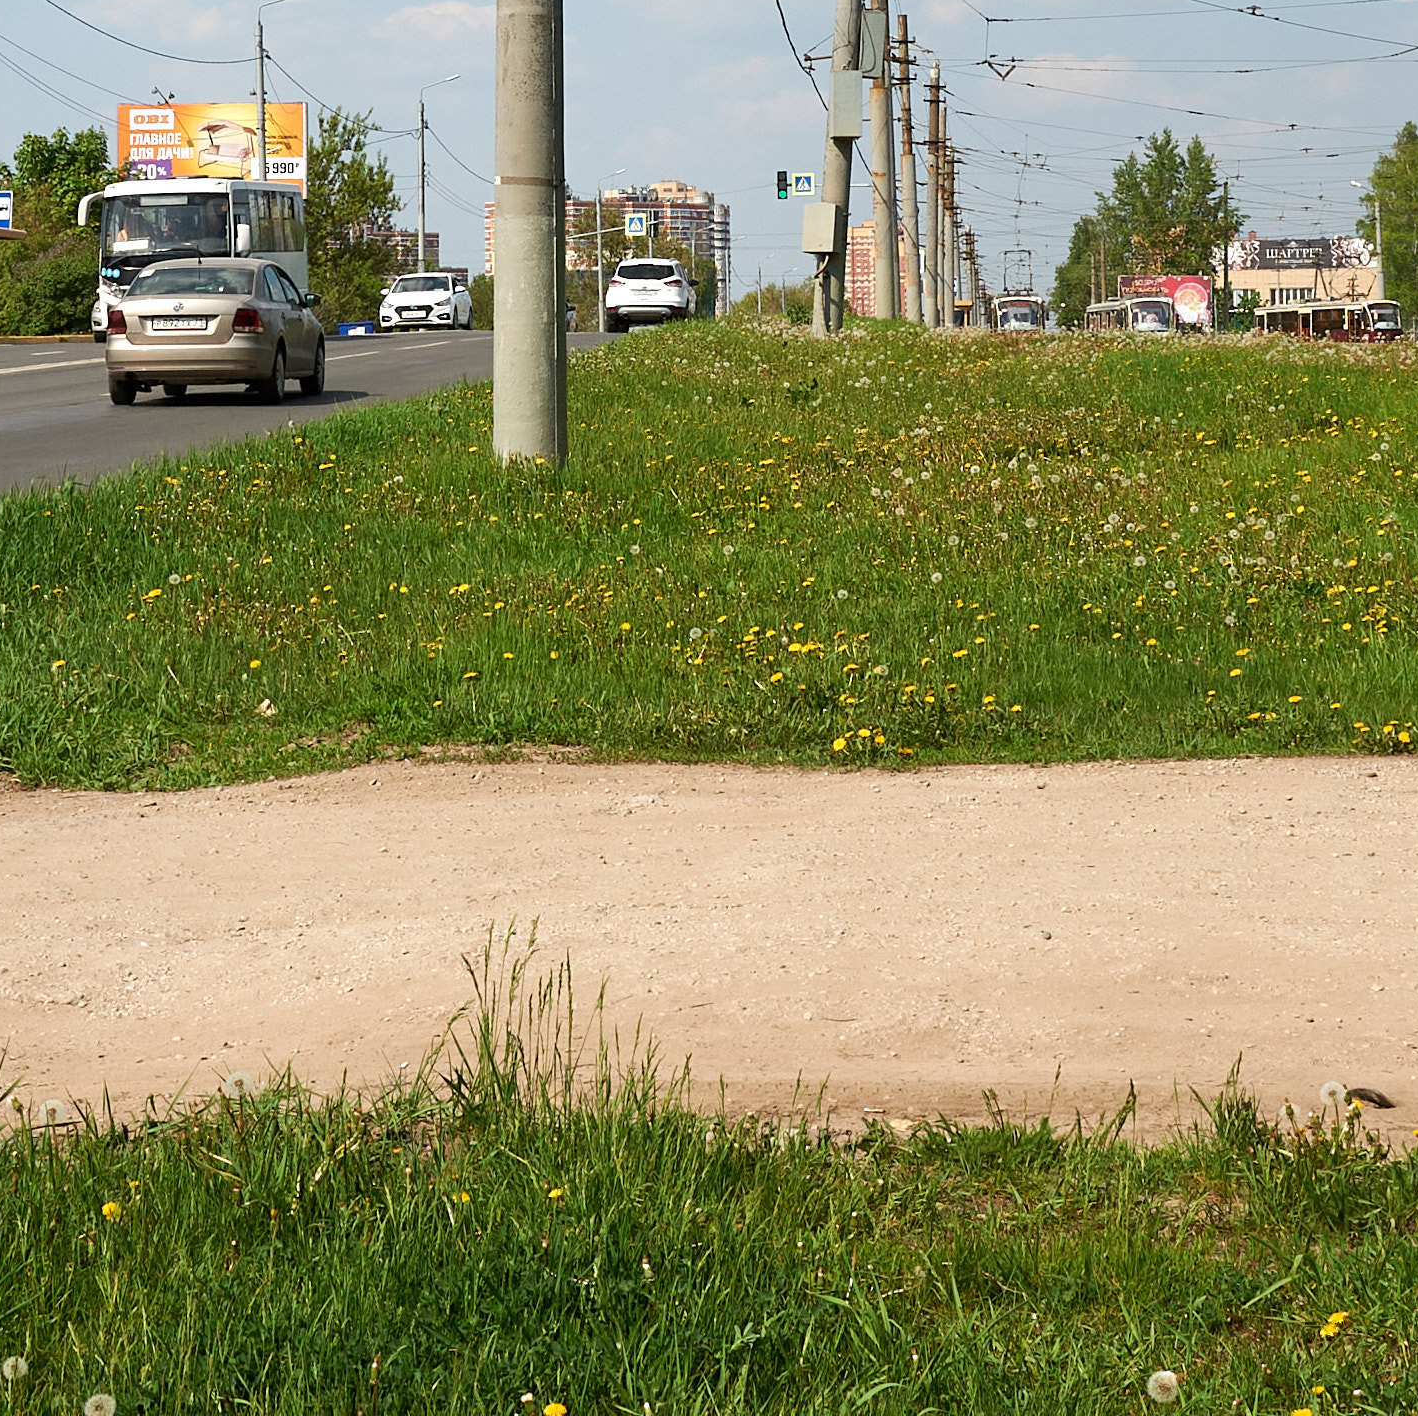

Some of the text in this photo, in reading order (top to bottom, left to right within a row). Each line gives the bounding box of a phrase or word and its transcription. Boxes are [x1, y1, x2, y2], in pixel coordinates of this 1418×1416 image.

[133, 114, 170, 124] OBI
[129, 132, 182, 146] ГЛАВНОЕ
[129, 146, 194, 161] ДЛЯ ДАЧИ!
